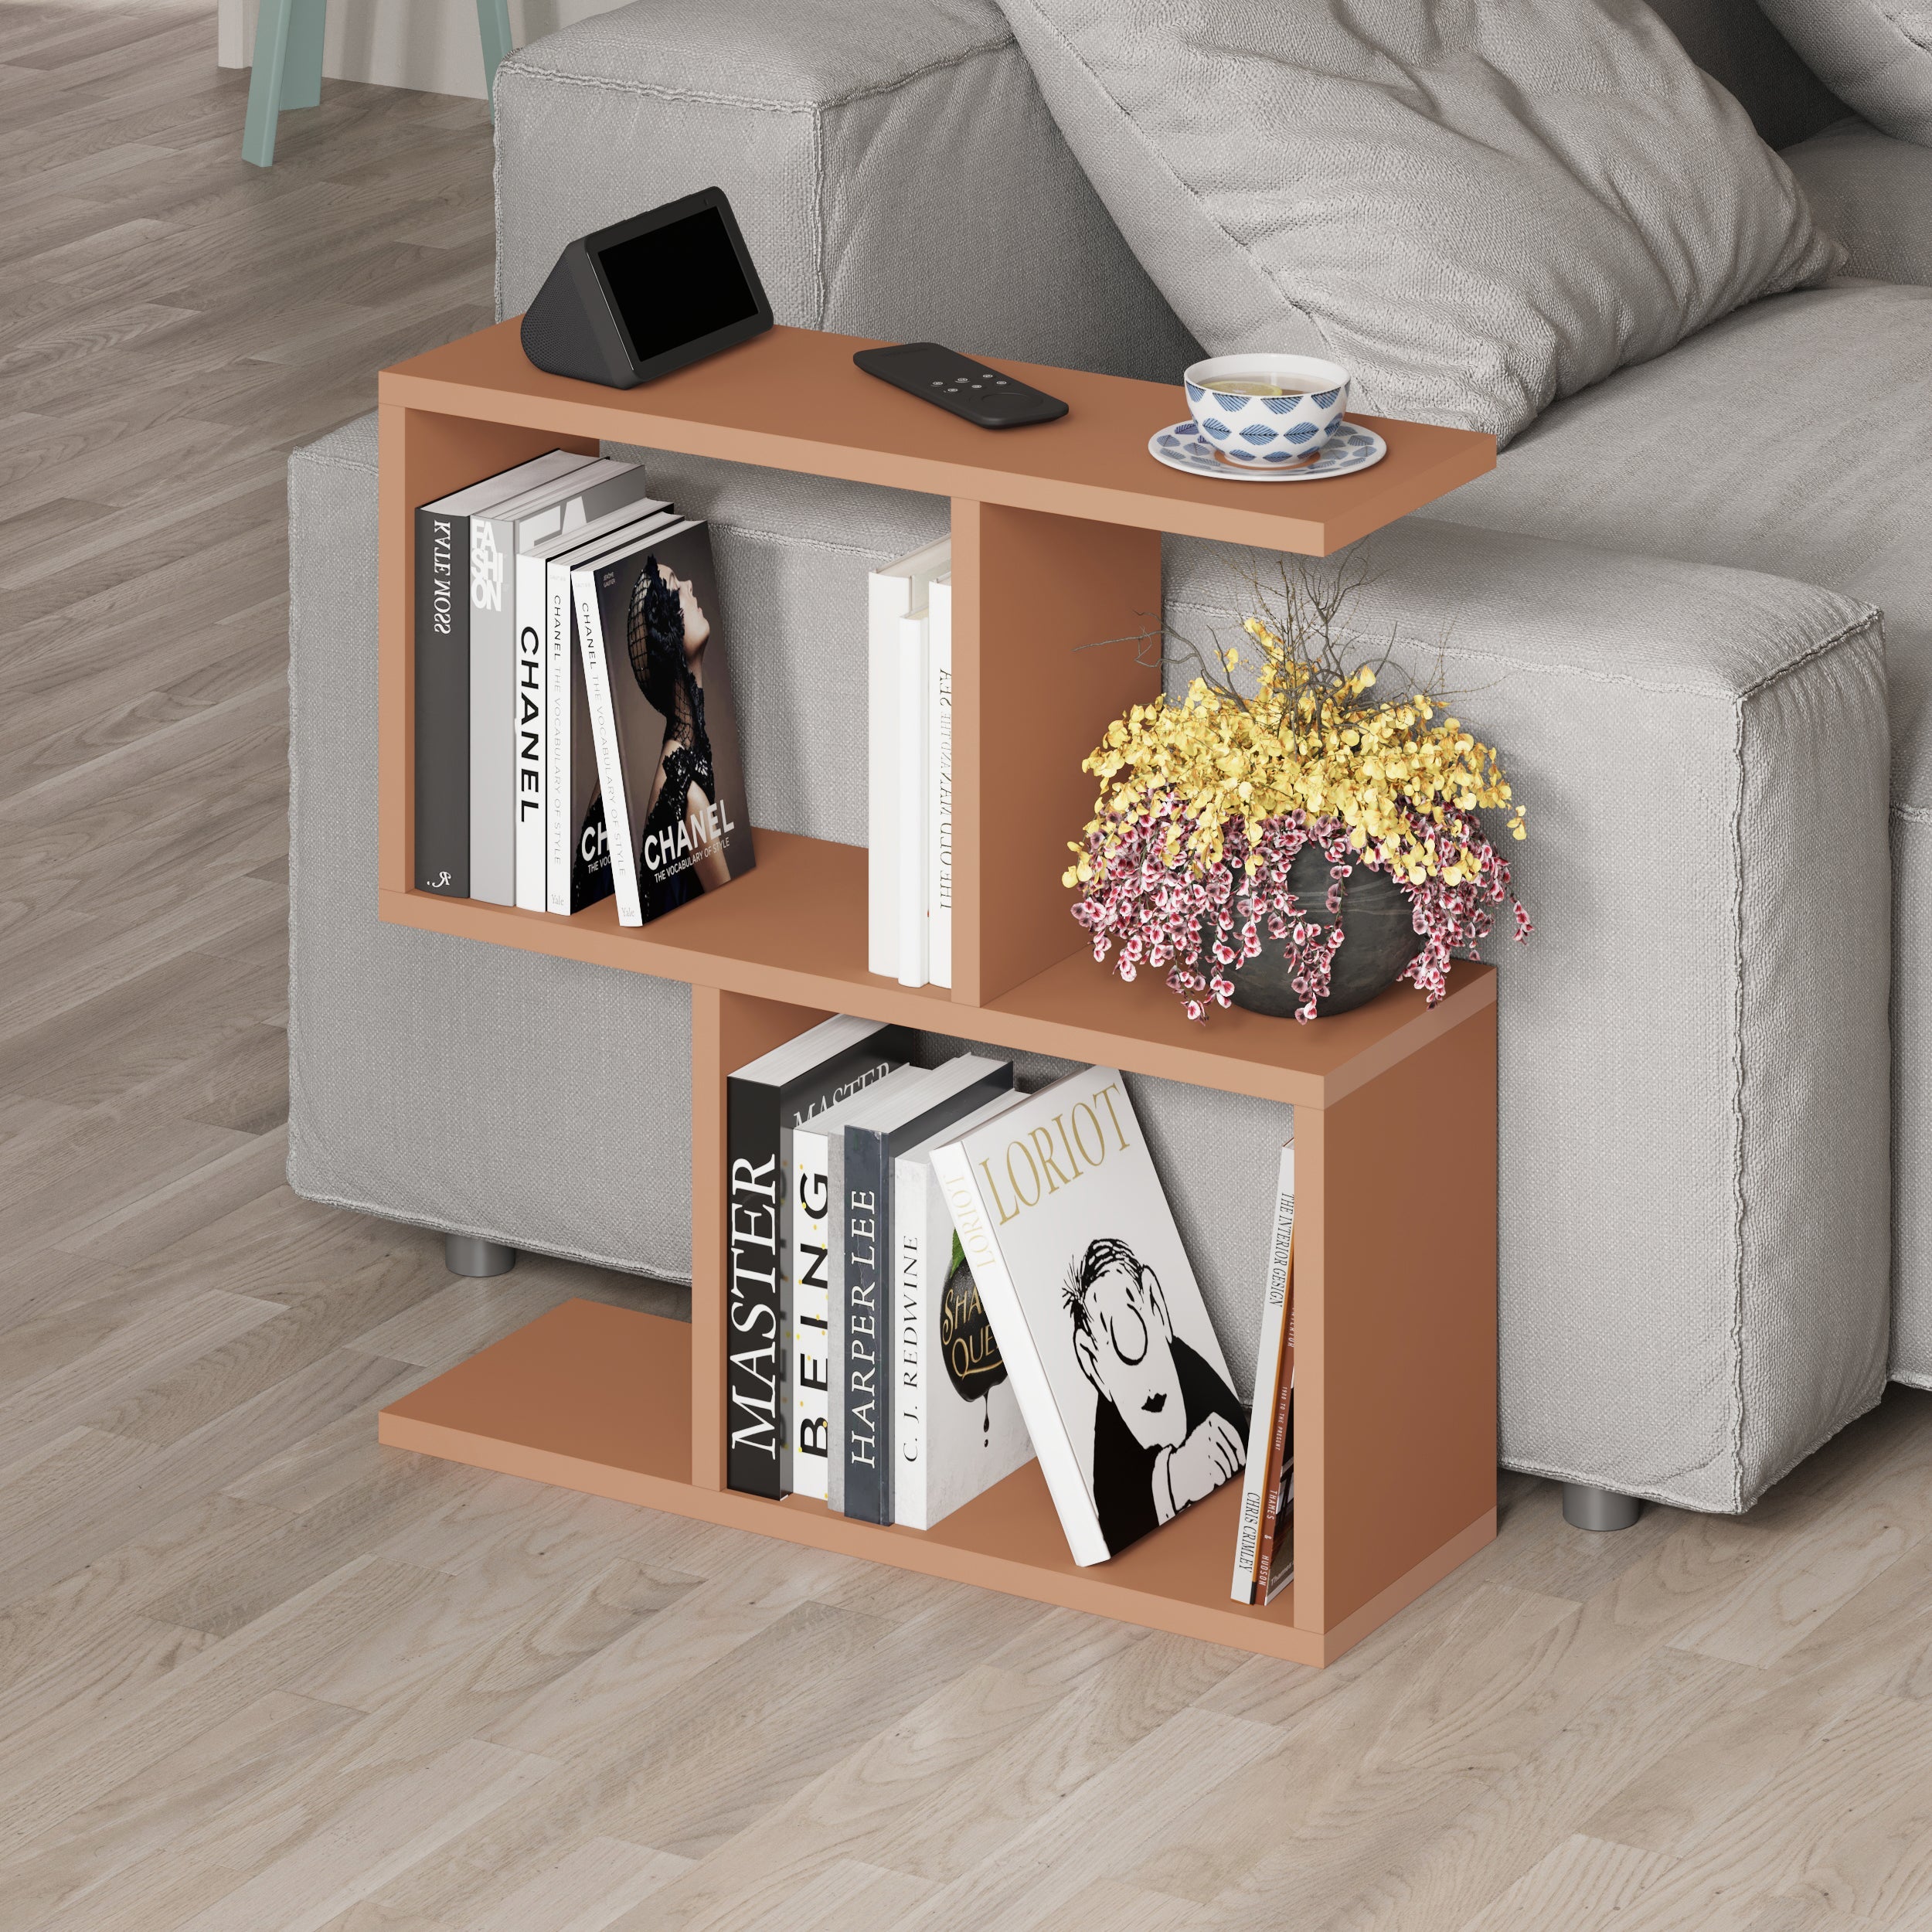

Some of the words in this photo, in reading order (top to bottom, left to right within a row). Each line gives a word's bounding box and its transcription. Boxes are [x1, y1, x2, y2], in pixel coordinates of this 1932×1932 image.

[582, 603, 597, 669] CHANEL
[593, 675, 602, 702] THE
[521, 626, 539, 822] CHANEL
[597, 706, 616, 804] VOCABULARY
[554, 798, 561, 816] OF
[611, 808, 619, 828] OF
[614, 832, 625, 876] STYLE
[645, 798, 734, 871] CHANEL
[587, 862, 599, 874] THE
[655, 870, 666, 883] THE
[666, 852, 704, 877] VOCABULARY
[704, 848, 713, 858] OF
[713, 837, 730, 854] STYLE
[551, 894, 564, 906] Yale
[621, 906, 634, 917] Yale
[978, 1083, 1131, 1226] LORIOT
[944, 1175, 996, 1267] LORIOT
[1279, 1192, 1294, 1214] THE
[851, 1190, 875, 1270] LEE
[1274, 1216, 1292, 1266] INTERIOR
[730, 1153, 777, 1461] MASTER
[800, 1172, 828, 1458] BEING
[903, 1236, 918, 1389] REDWINE
[851, 1281, 876, 1469] HARPER
[903, 1405, 920, 1423] J.
[903, 1437, 918, 1462] C.
[1244, 1492, 1260, 1526] CHRIS
[1267, 1490, 1277, 1520] THAMES
[1239, 1526, 1257, 1573] CRIMLEY
[1258, 1555, 1269, 1587] HUDSON
